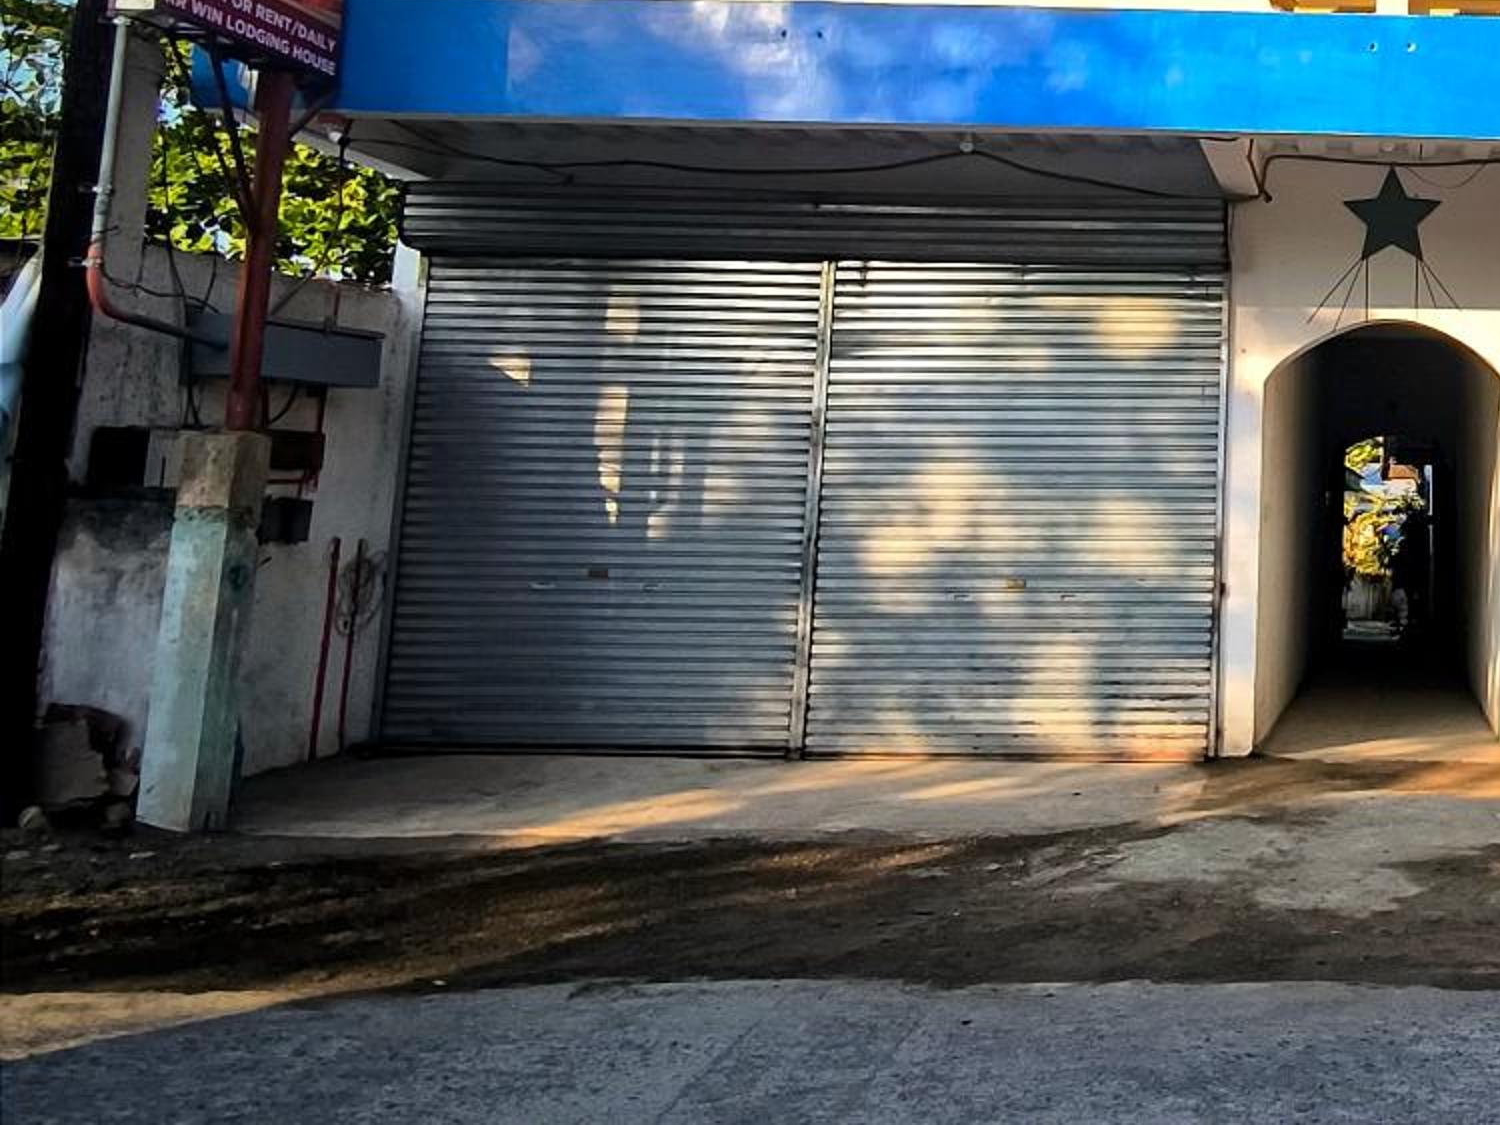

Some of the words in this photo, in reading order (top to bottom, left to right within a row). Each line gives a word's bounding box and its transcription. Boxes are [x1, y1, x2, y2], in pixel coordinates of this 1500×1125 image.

[225, 14, 290, 55] LODGING
[293, 44, 336, 76] HOUSE
[255, 3, 336, 53] RENT/DAILY
